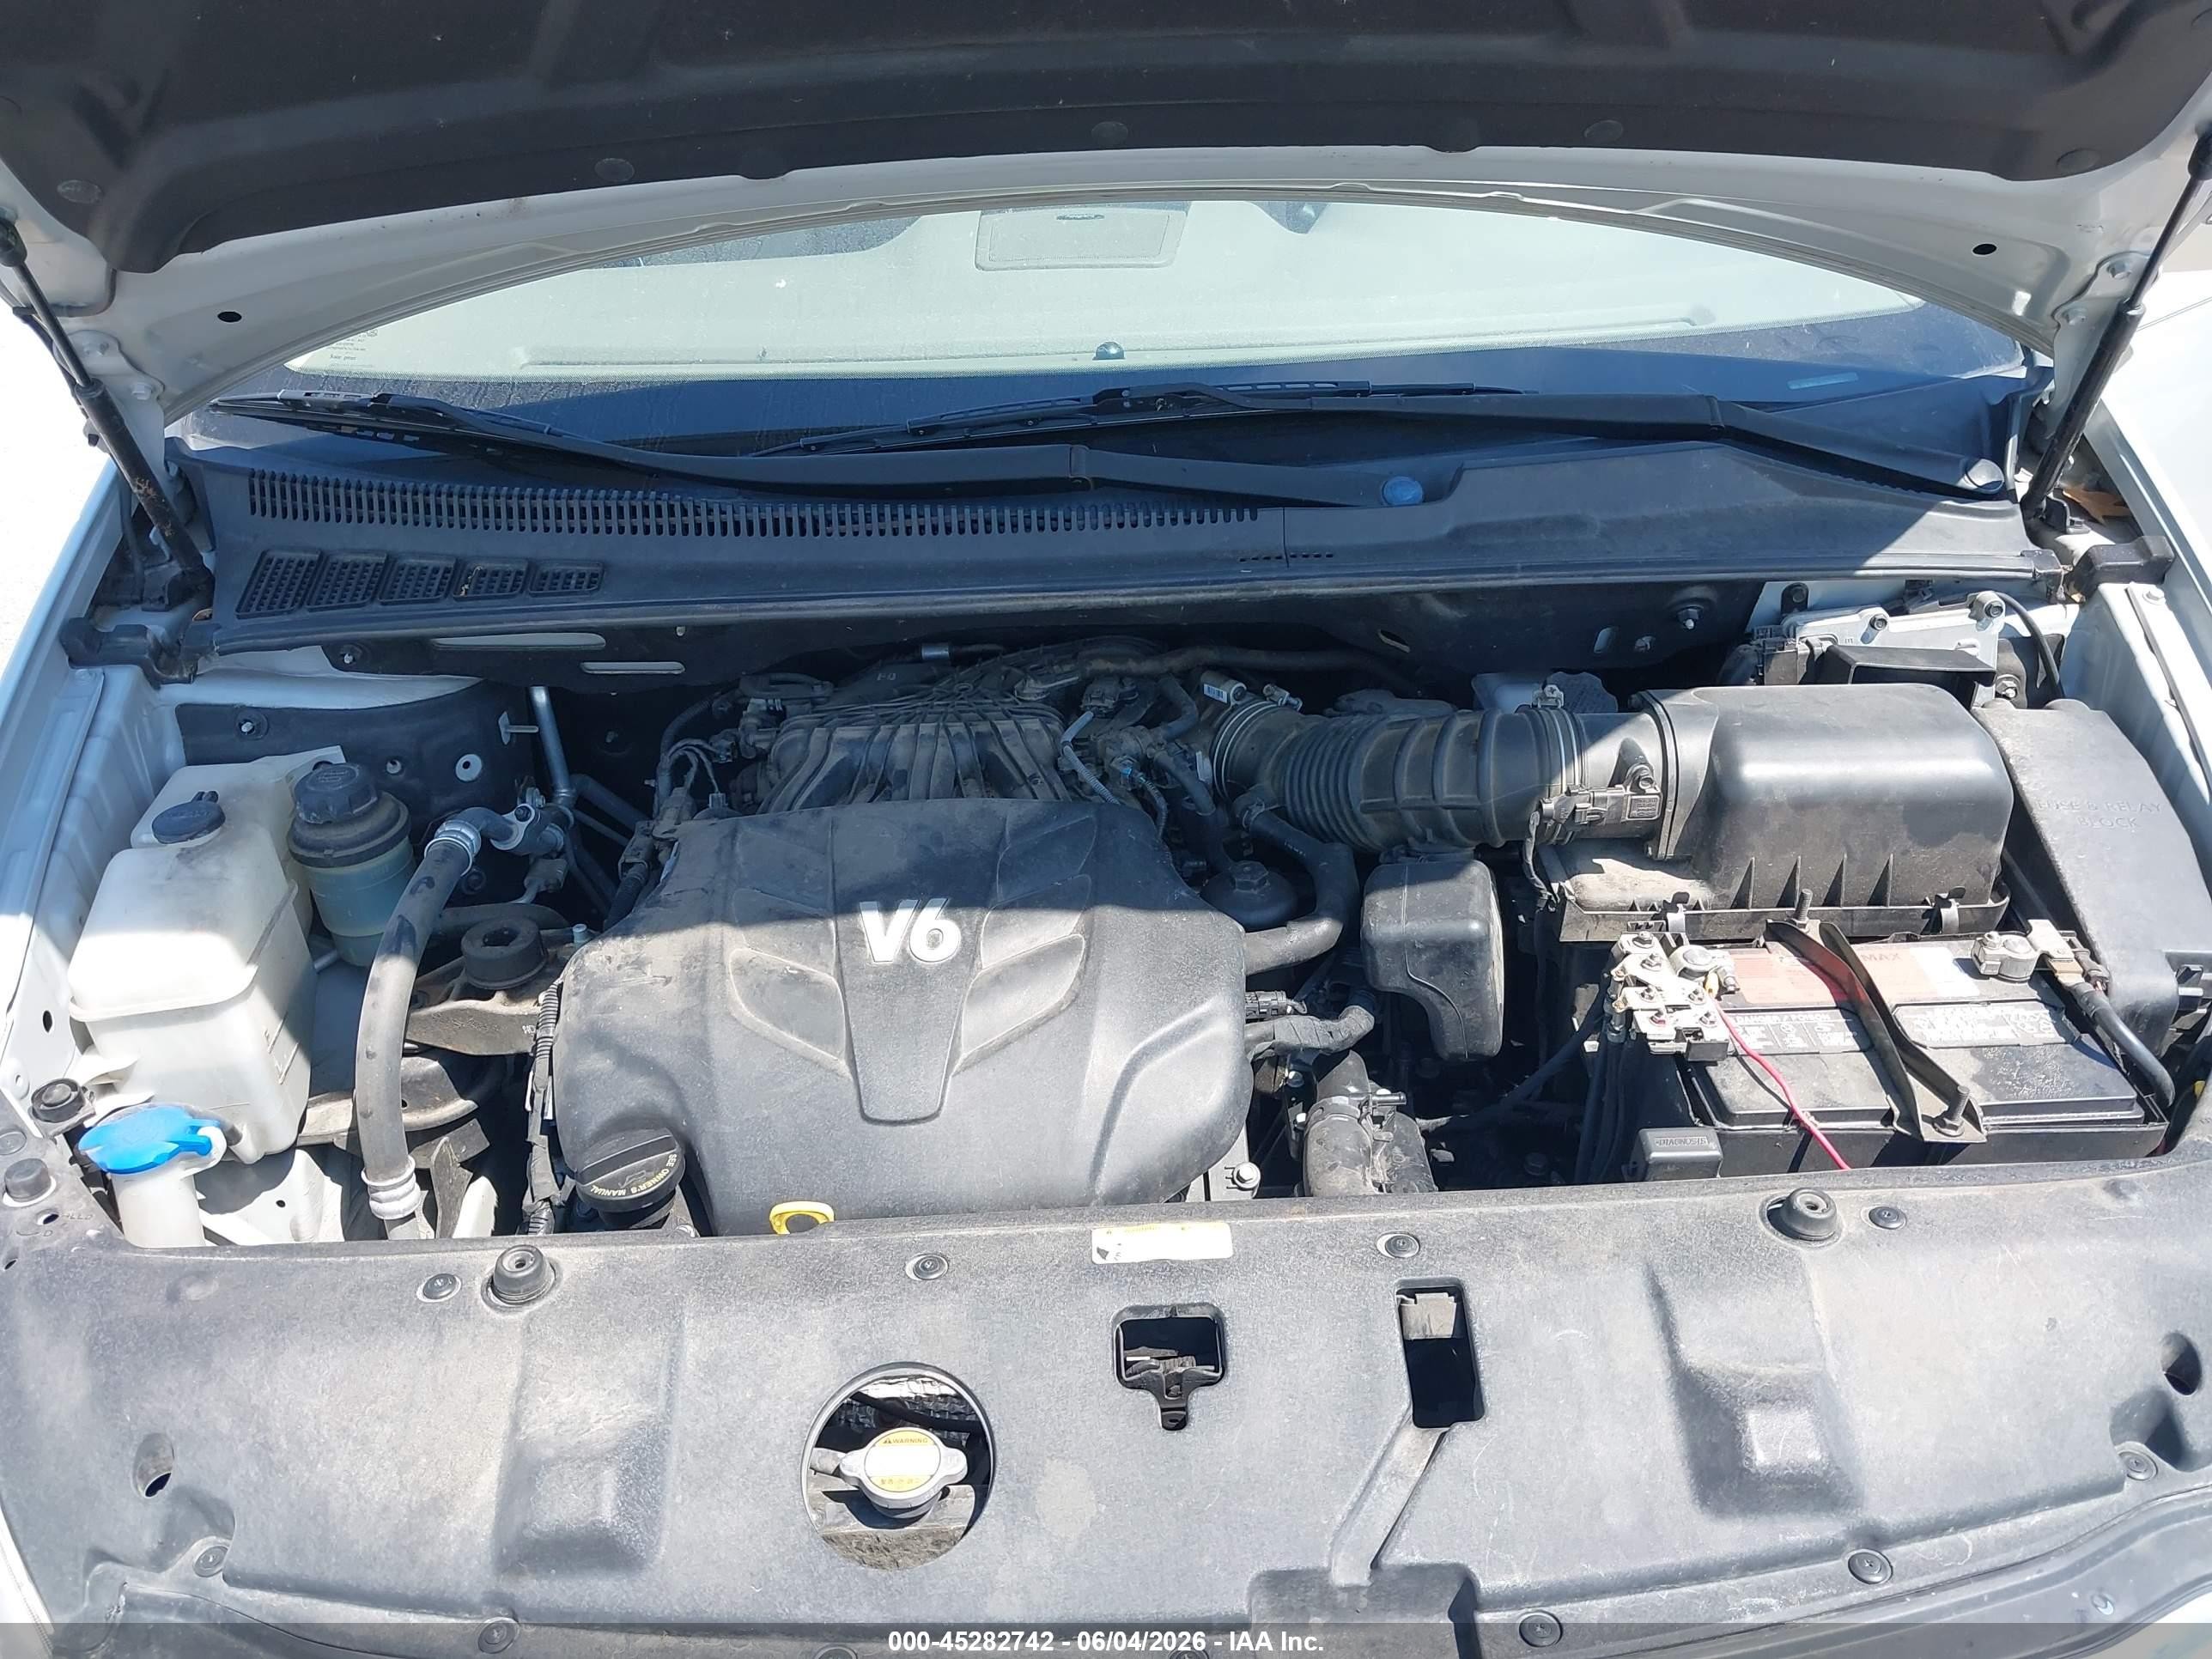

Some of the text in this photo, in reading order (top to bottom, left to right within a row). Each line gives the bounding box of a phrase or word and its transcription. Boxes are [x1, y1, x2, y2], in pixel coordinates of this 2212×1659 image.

[2106, 801, 2161, 812] RELAY
[2077, 817, 2141, 830] BLOCK
[860, 898, 962, 963] V6
[590, 1153, 678, 1197] SEE OWNER'S MANUAL
